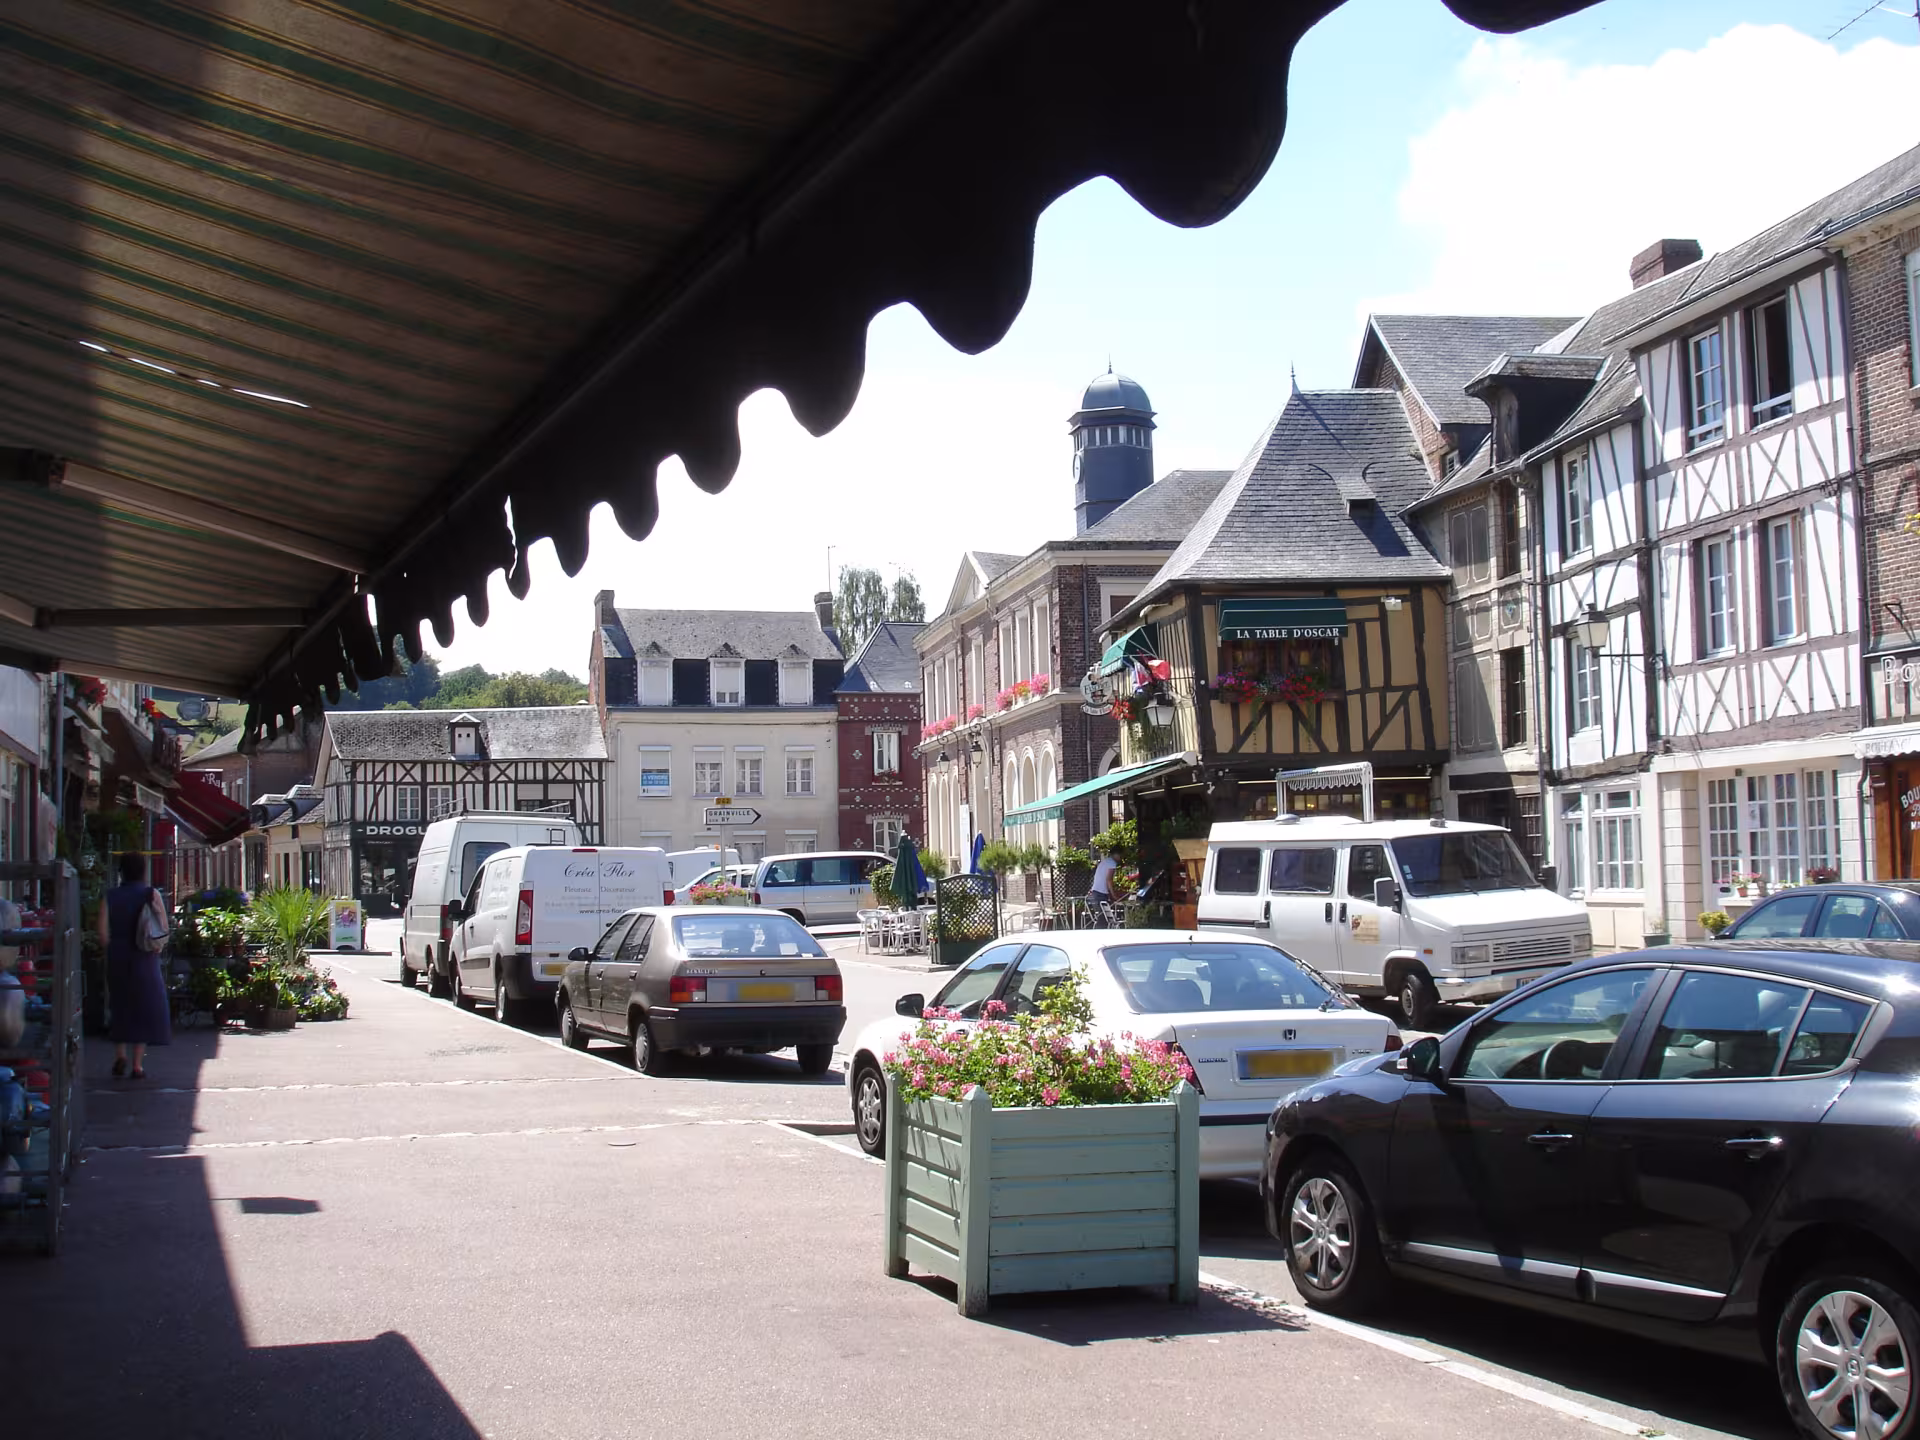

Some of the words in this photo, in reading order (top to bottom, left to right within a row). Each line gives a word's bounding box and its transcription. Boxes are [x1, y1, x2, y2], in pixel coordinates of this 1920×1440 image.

[1236, 629, 1250, 639] LA
[1254, 629, 1288, 639] TABLE
[1293, 627, 1340, 638] D'OSCAR
[1900, 784, 1920, 809] BOU
[564, 862, 595, 878] Créa
